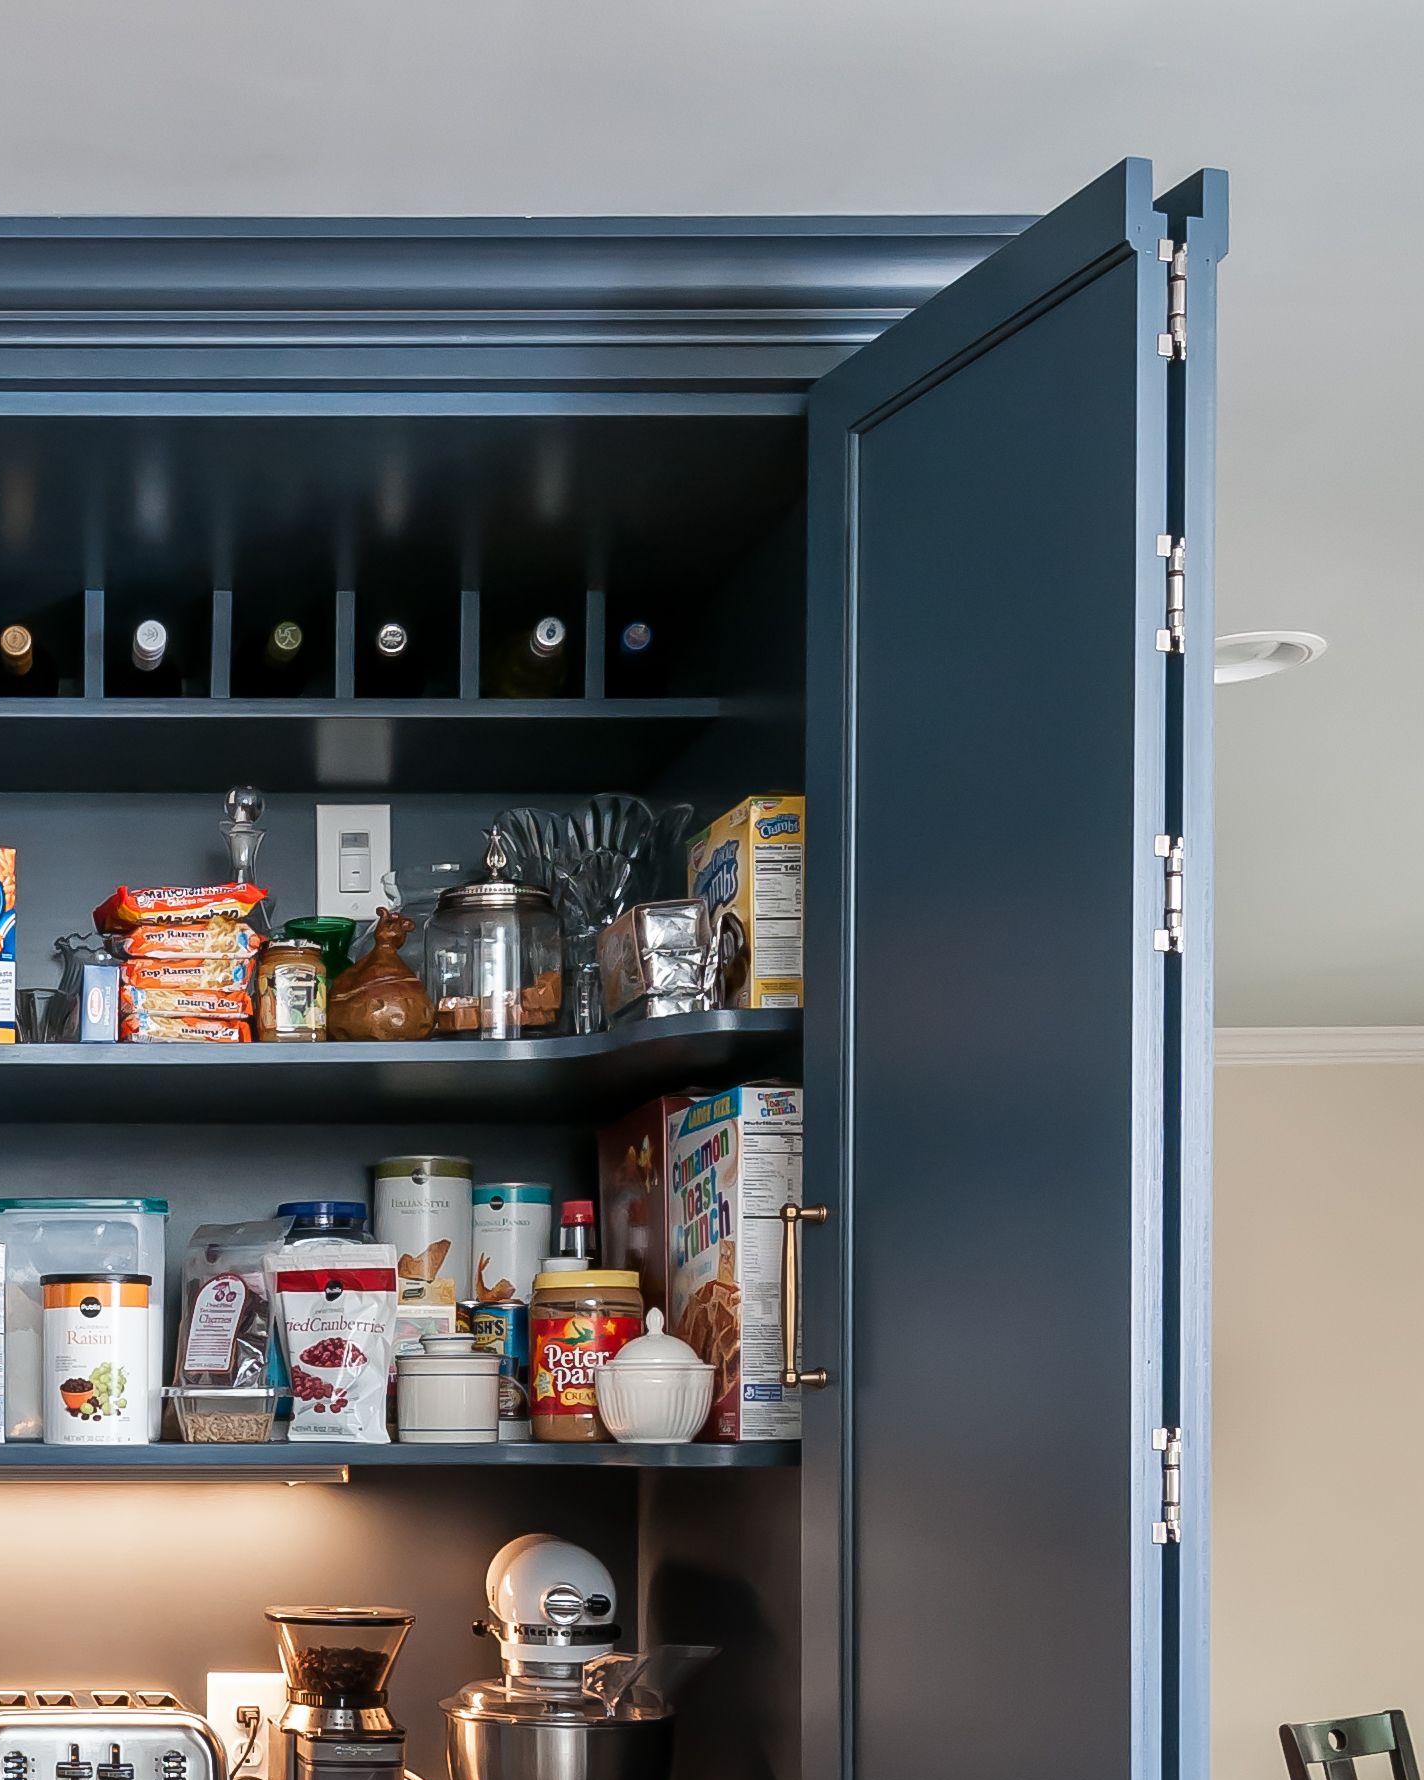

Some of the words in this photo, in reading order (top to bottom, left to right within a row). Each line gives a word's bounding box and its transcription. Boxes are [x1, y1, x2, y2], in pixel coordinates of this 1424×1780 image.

[783, 864, 801, 872] 140
[145, 932, 164, 941] Top
[167, 930, 205, 939] Ramen
[141, 969, 161, 977] Top
[162, 967, 201, 975] Ramen
[177, 998, 215, 1010] Ramen
[672, 1127, 730, 1194] Cinnamon
[681, 1165, 718, 1225] Toast
[677, 1191, 731, 1268] Crunch
[285, 1317, 310, 1332] ried
[310, 1315, 386, 1334] Cranberries
[475, 1319, 504, 1336] SH'S
[543, 1344, 610, 1370] Peter
